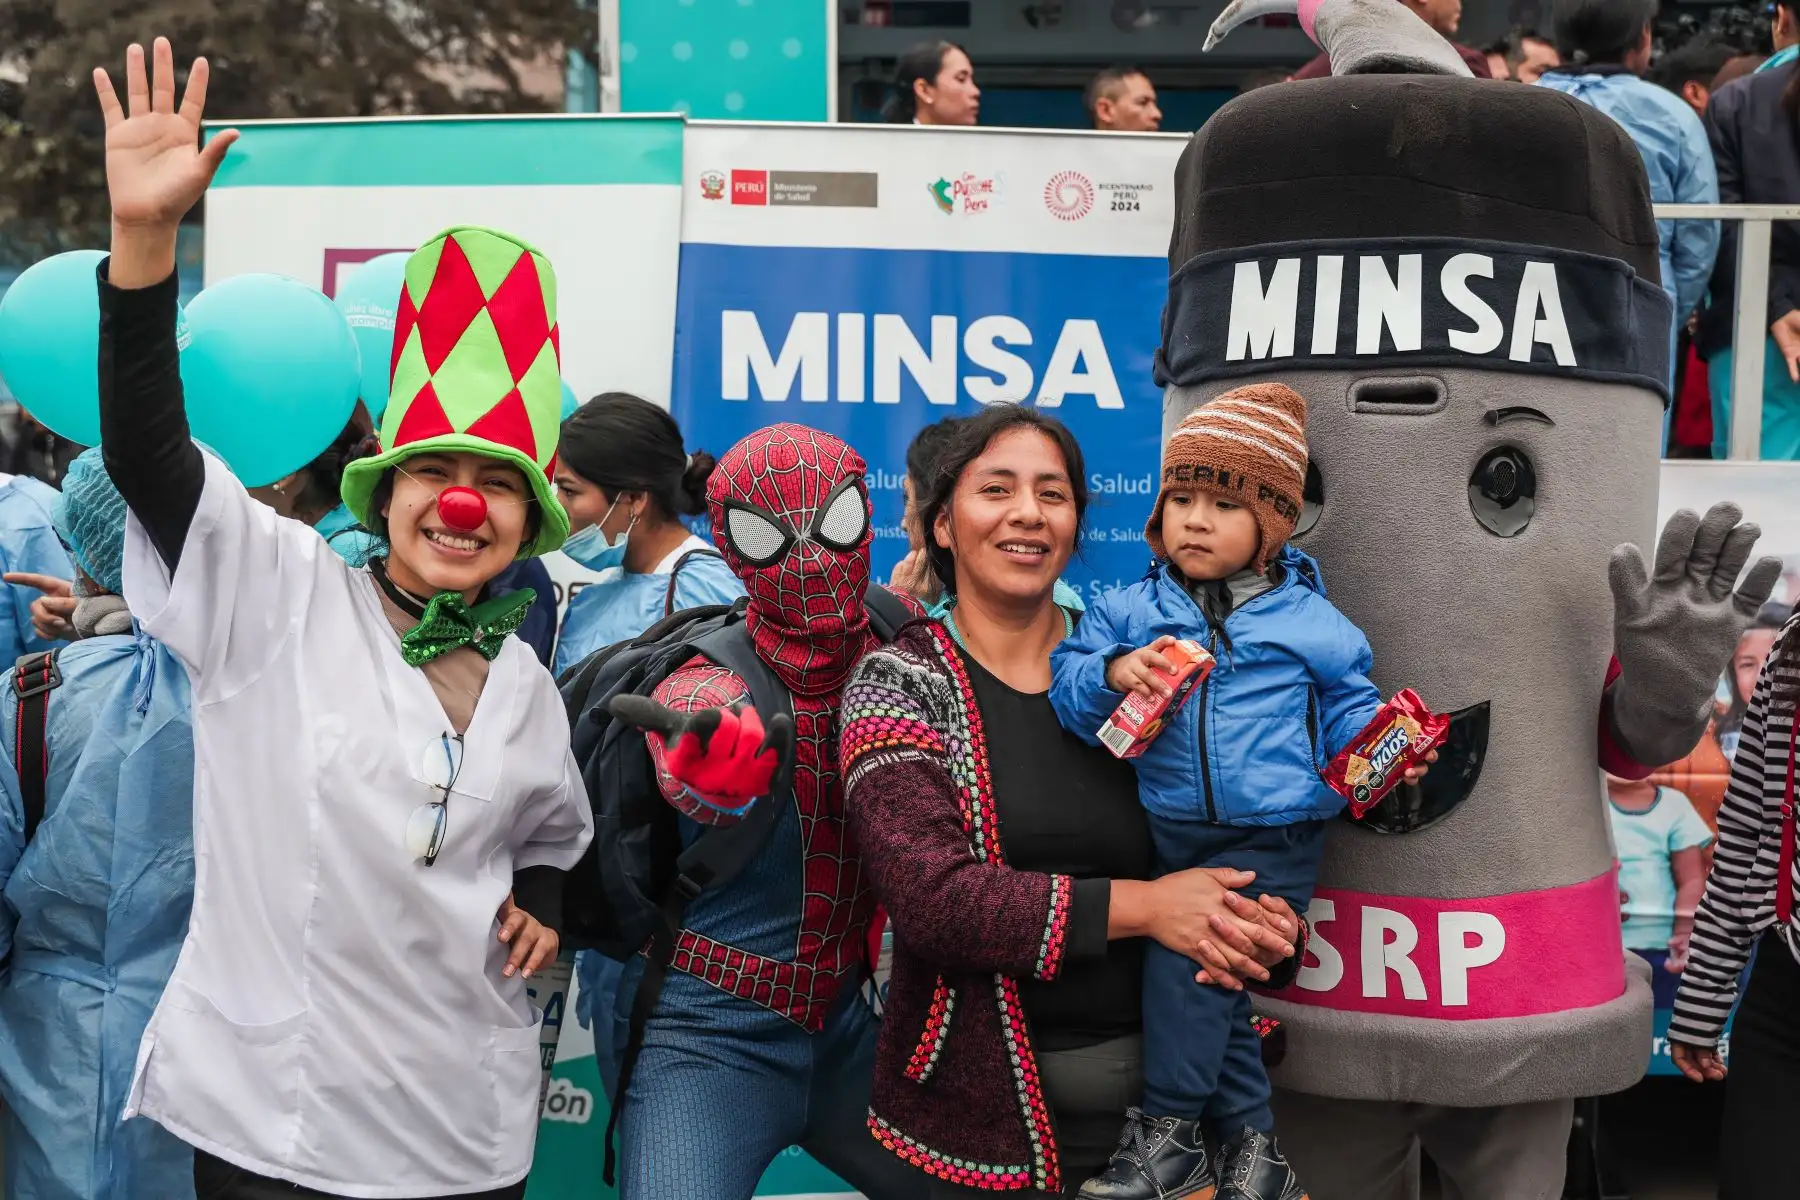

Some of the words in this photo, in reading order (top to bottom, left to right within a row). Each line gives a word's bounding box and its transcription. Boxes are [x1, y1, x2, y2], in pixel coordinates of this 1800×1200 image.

[734, 180, 764, 193] PERÚ
[1098, 183, 1154, 191] BICENTENARIO
[1113, 191, 1138, 200] PERÚ
[1111, 201, 1140, 211] 2024
[1226, 253, 1577, 367] MINSA
[722, 310, 1125, 410] MINSA
[1091, 473, 1152, 494] Salud
[1089, 527, 1107, 542] de
[1369, 727, 1409, 773] SODA
[1296, 898, 1505, 1005] SRP
